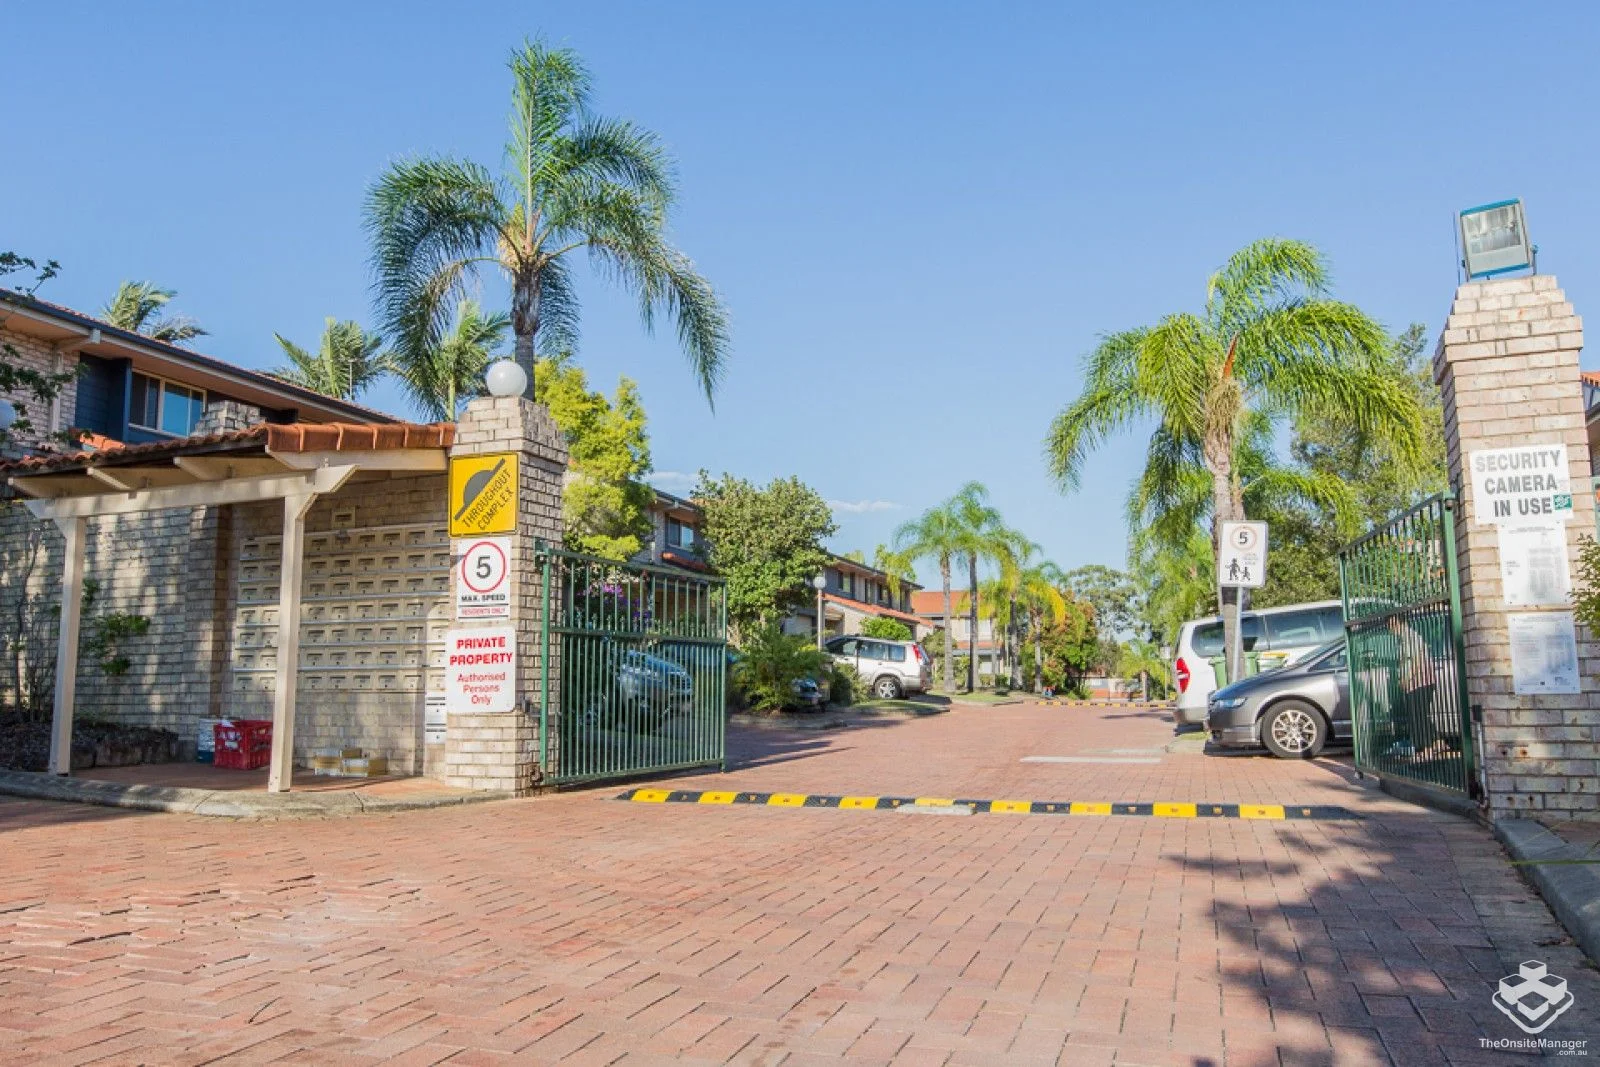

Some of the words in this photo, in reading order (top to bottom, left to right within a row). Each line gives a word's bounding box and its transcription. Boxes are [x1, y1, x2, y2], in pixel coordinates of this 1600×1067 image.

[1475, 450, 1560, 472] SECURITY
[1485, 473, 1558, 495] CAMERA
[463, 469, 511, 527] THROUGHOUT
[477, 487, 514, 530] COMPLEX
[1494, 500, 1511, 517] IN
[1518, 497, 1553, 515] USE
[1239, 531, 1248, 544] 5
[476, 555, 492, 579] 5
[482, 593, 506, 601] SPEED
[456, 637, 506, 649] PRIVATE
[449, 652, 513, 665] PROPERTY
[457, 672, 506, 682] Authorised
[463, 684, 500, 693] Persons
[471, 695, 492, 705] Only
